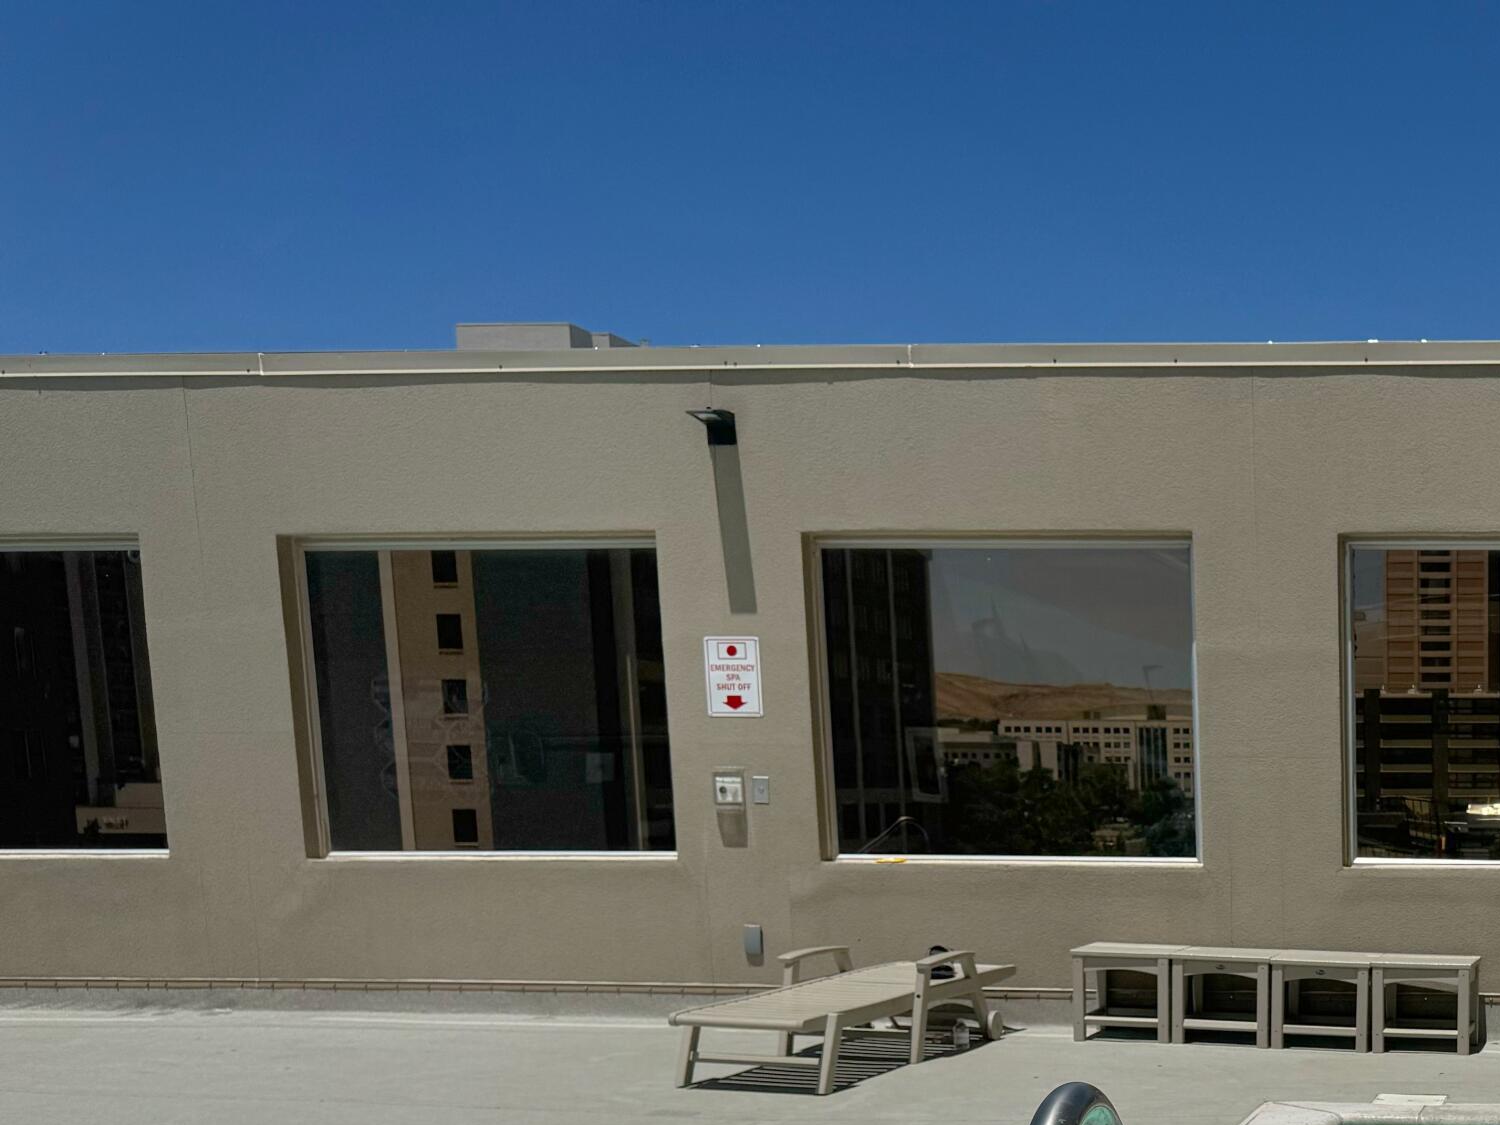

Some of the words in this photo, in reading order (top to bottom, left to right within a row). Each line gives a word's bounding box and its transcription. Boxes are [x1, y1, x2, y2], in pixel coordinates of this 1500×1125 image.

[710, 664, 755, 672] EMERGENCY
[726, 673, 741, 681] SPA
[716, 683, 736, 691] SHUT
[737, 683, 752, 691] OFF
